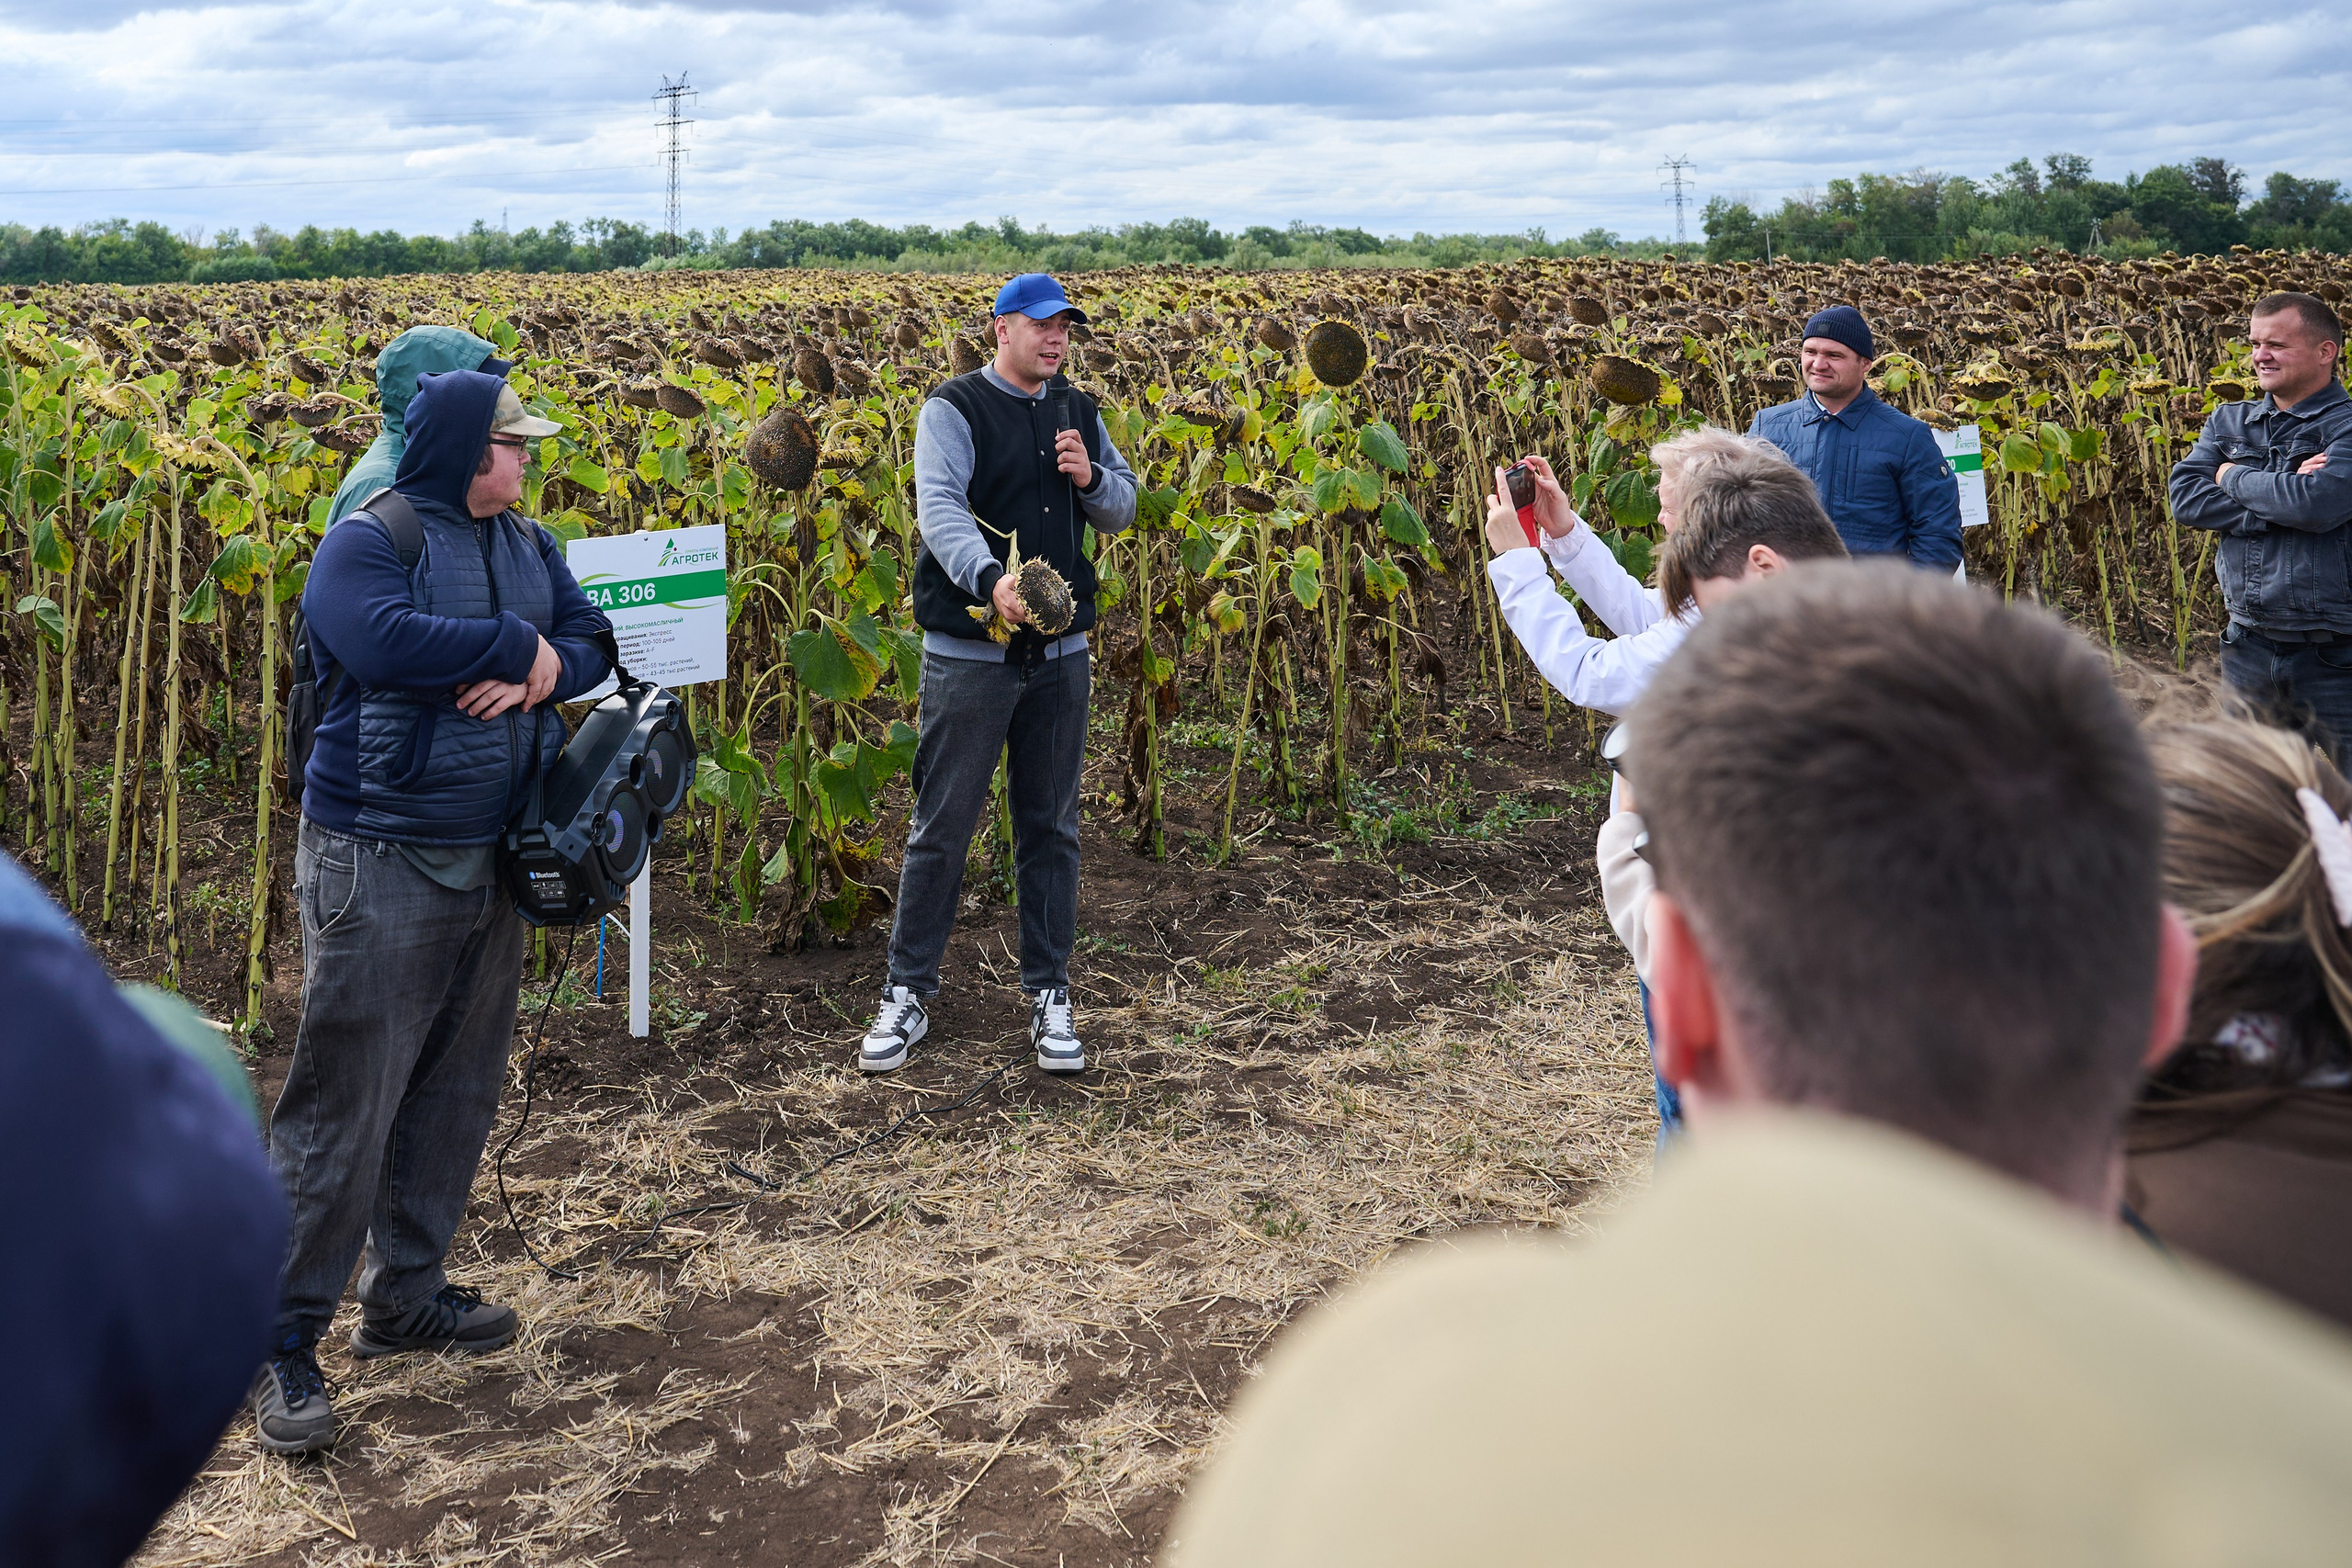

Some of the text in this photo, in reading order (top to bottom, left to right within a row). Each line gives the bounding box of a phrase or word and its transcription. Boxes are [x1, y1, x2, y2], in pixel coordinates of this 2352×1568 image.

[672, 552, 718, 565] АГРОТЕК
[618, 582, 656, 604] 306
[626, 617, 684, 630] ВЫСОКОМАСЛИЧНЫЙ
[642, 637, 662, 646] 100-105
[627, 657, 648, 665] уборки:
